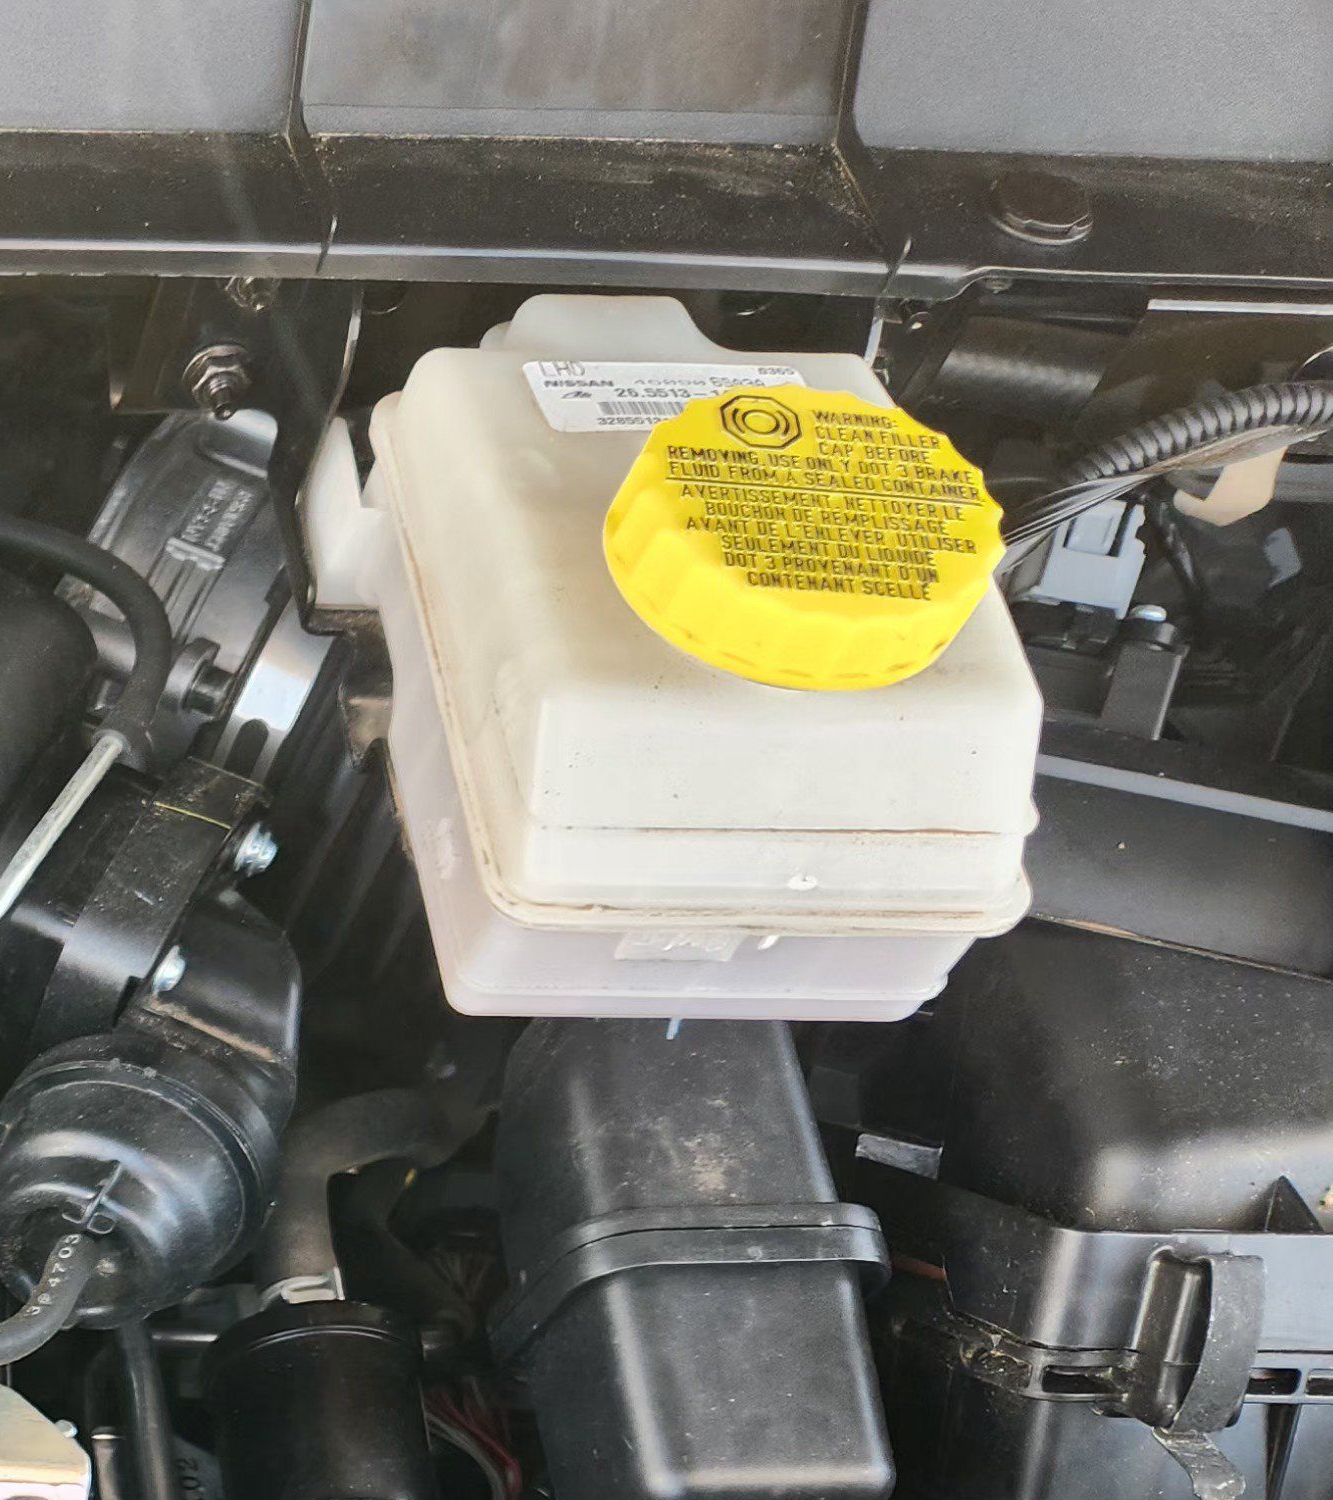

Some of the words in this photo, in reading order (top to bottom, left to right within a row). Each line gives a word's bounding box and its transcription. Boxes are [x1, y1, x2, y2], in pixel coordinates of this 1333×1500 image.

[543, 379, 615, 388] NISSAN
[812, 410, 898, 428] WARNING:
[815, 426, 875, 443] CLEAN
[880, 431, 941, 449] FILLER
[819, 441, 853, 457] CAP
[865, 445, 931, 464] BEFORE
[668, 461, 720, 478] FLUID
[728, 466, 777, 482] FROM
[786, 471, 797, 484] A
[804, 472, 875, 490] SEALED
[882, 478, 980, 499] CONTAINER
[767, 454, 800, 469] USE
[805, 456, 850, 472] ONLY
[858, 461, 890, 475] DOT
[895, 464, 908, 479] 3
[914, 465, 976, 484] BRAKE
[705, 501, 786, 520] BOUCHON
[792, 508, 813, 523] DE
[822, 511, 950, 535] REMPLISSAGE
[843, 496, 938, 517] NETTOYER
[942, 505, 965, 521] LE
[686, 517, 749, 534] AVANT
[757, 521, 780, 537] DE
[896, 533, 977, 554] UTILISER
[721, 535, 829, 556] SEULEMENT
[838, 543, 860, 558] DU
[866, 547, 935, 565] LIQUIDE
[724, 551, 757, 568] DOT
[764, 556, 776, 571] 3
[783, 556, 890, 579] PROVENANT
[747, 571, 855, 594] CONTENANT
